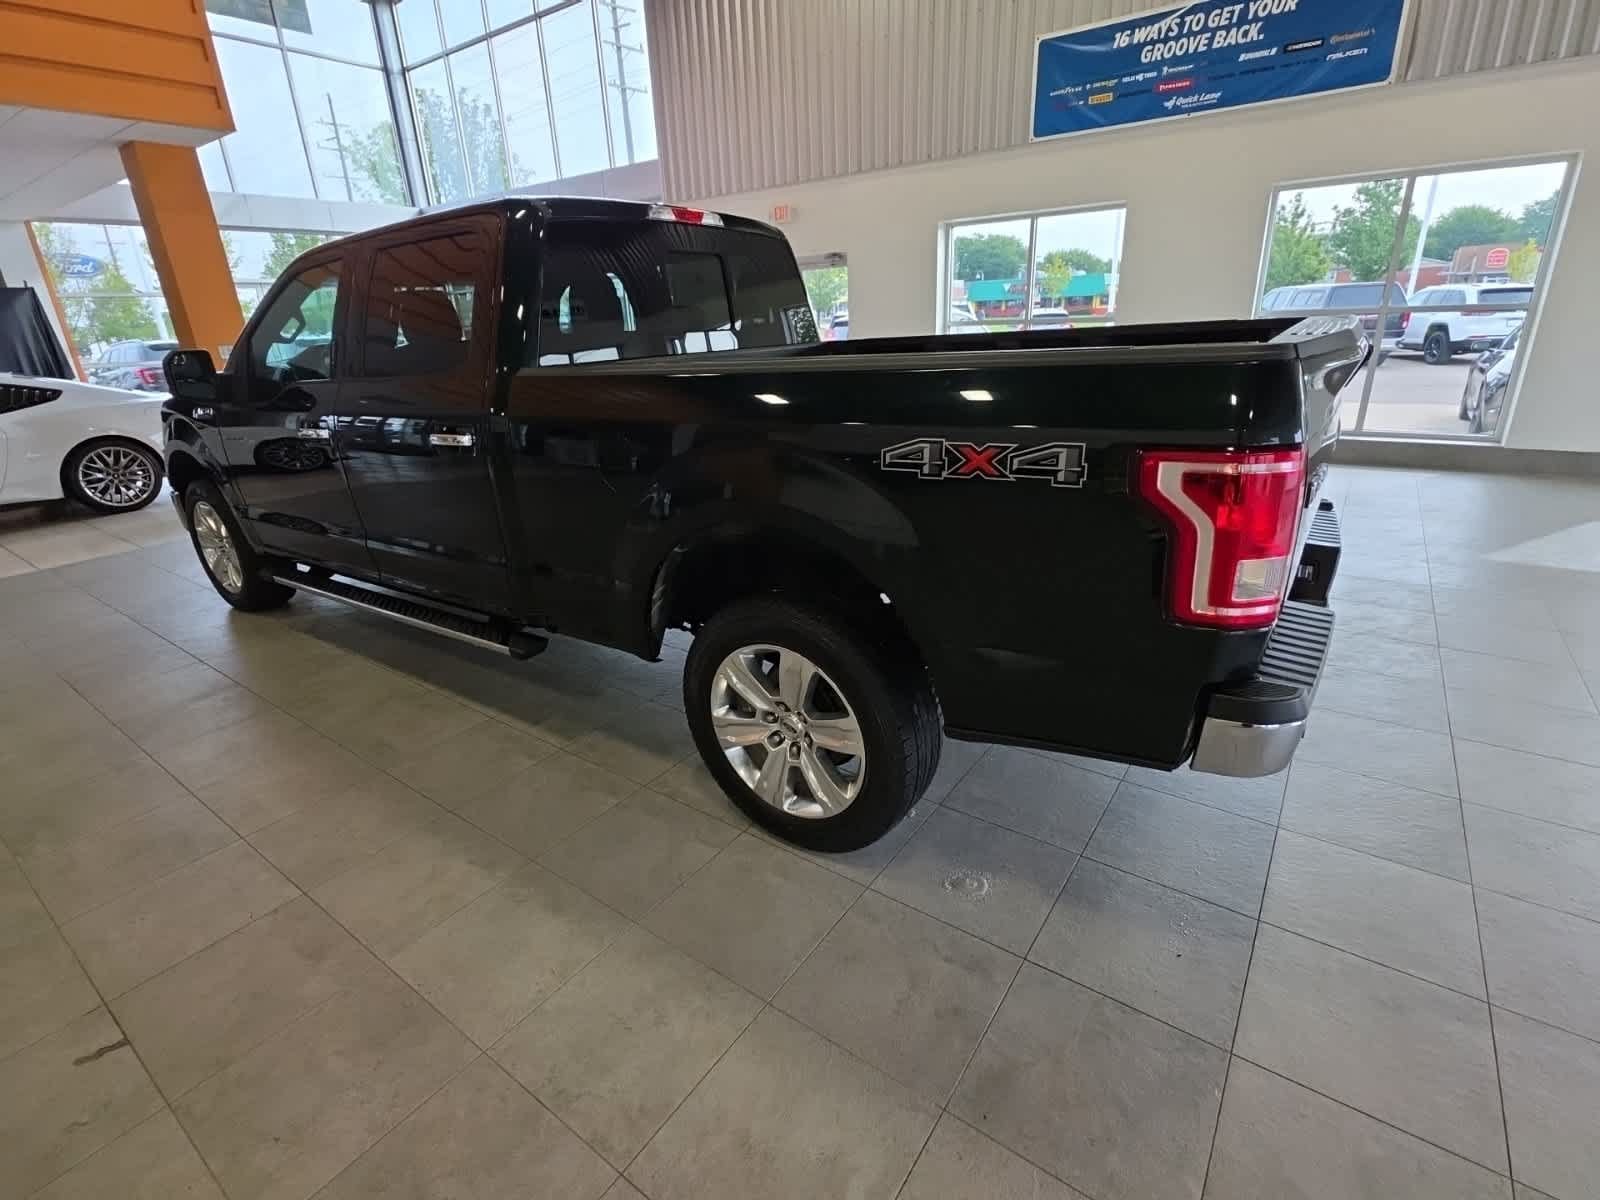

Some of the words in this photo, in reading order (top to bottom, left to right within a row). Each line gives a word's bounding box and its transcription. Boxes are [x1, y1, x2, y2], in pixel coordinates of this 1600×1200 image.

[1113, 30, 1131, 49] 16
[1133, 15, 1180, 45] WAYS
[1183, 12, 1205, 34] TO
[1207, 4, 1244, 29] GET
[1247, 0, 1299, 20] YOUR
[1140, 33, 1211, 63] GROOVE
[1212, 21, 1265, 50] BACK.
[1175, 93, 1199, 106] Quick
